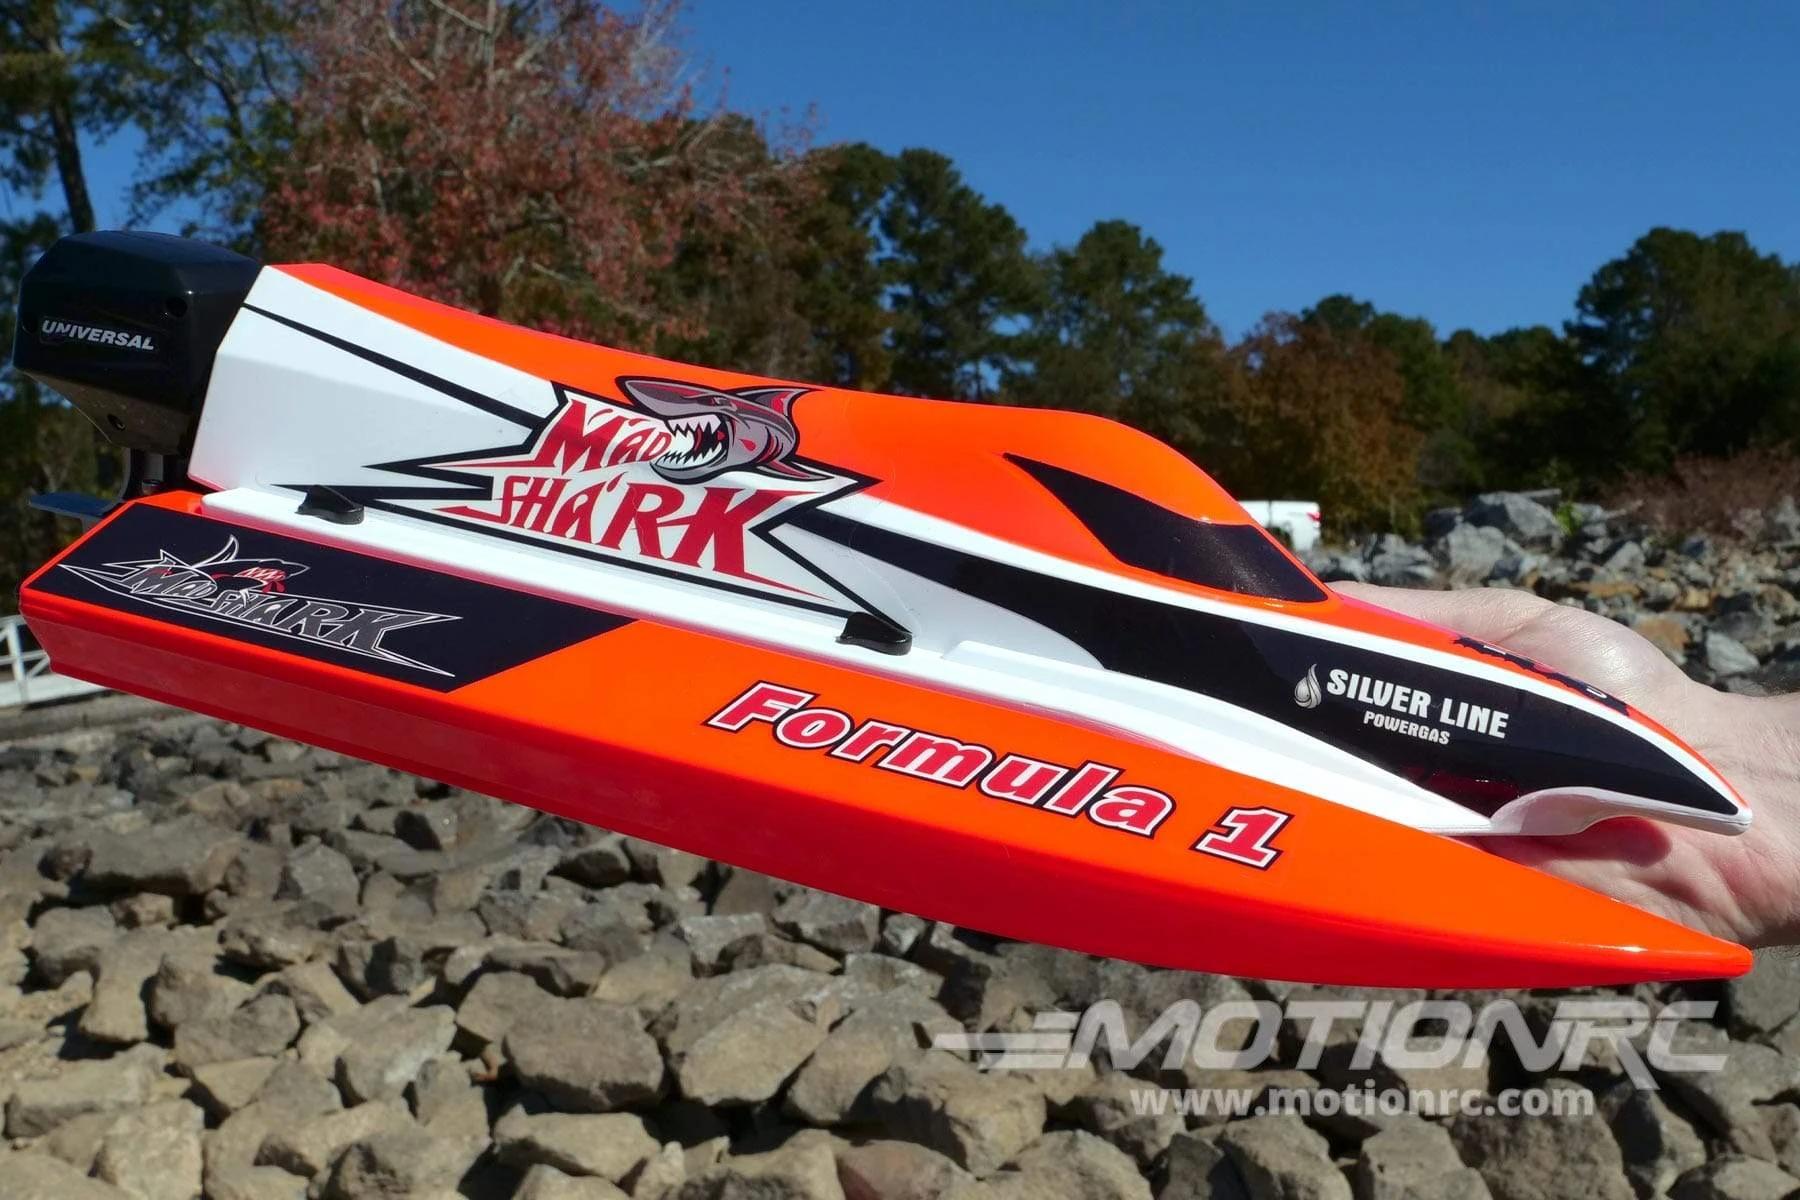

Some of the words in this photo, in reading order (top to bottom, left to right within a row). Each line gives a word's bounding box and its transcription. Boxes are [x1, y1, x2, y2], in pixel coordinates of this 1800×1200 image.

[41, 319, 155, 351] UNIVERSAL
[452, 470, 818, 597] SHARK
[1327, 668, 1432, 719] SILVER
[1440, 697, 1510, 739] LINE
[1363, 709, 1451, 746] POWERGAS
[703, 680, 1176, 838] Formula
[1190, 805, 1294, 870] 1
